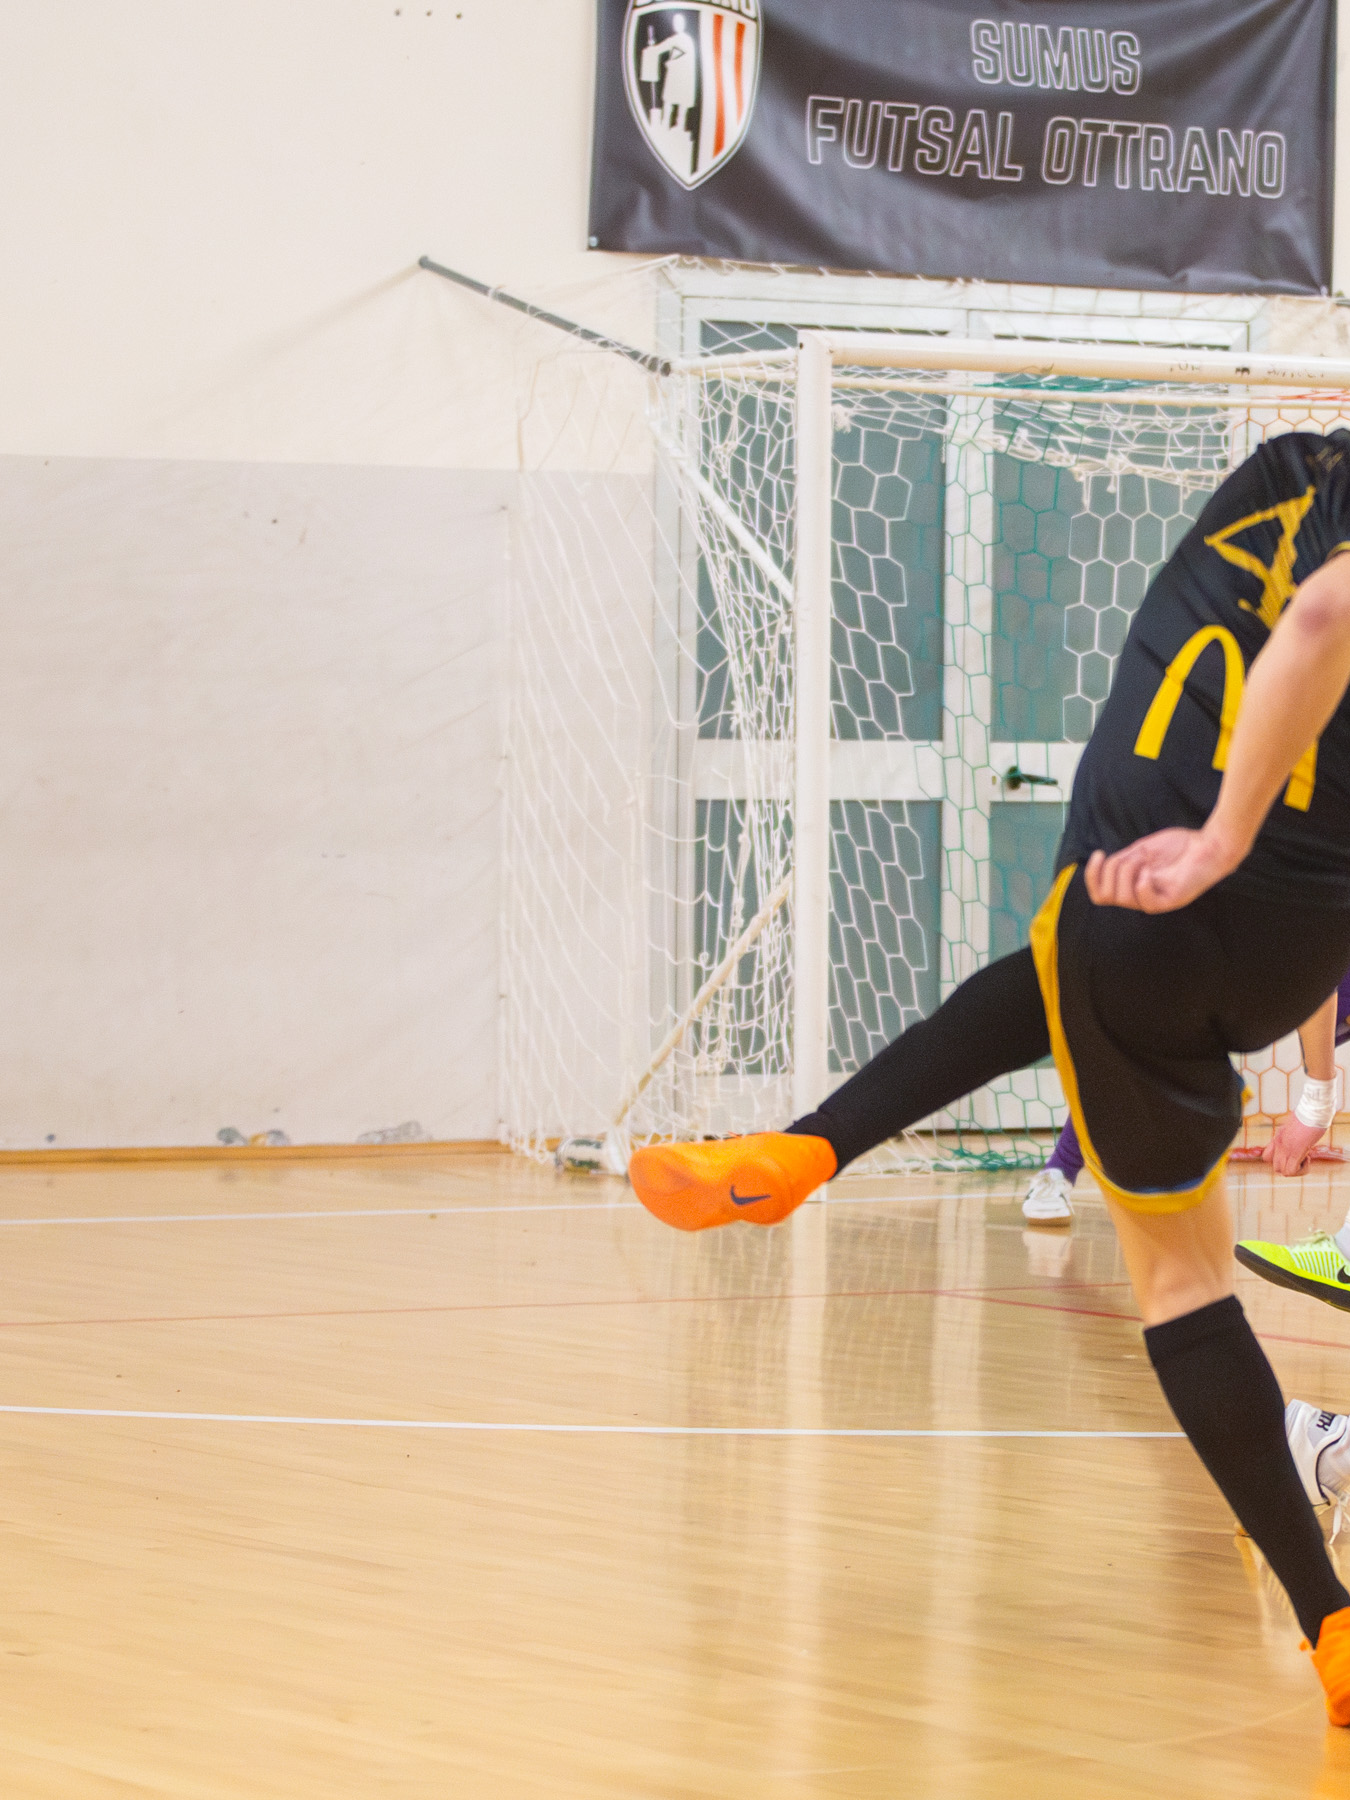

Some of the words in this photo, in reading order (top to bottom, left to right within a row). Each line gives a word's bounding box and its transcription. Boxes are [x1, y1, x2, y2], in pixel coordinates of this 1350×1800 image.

[971, 19, 1141, 96] SUMUS
[806, 95, 1023, 182] FUTSAL
[1041, 116, 1286, 199] OTTRANO
